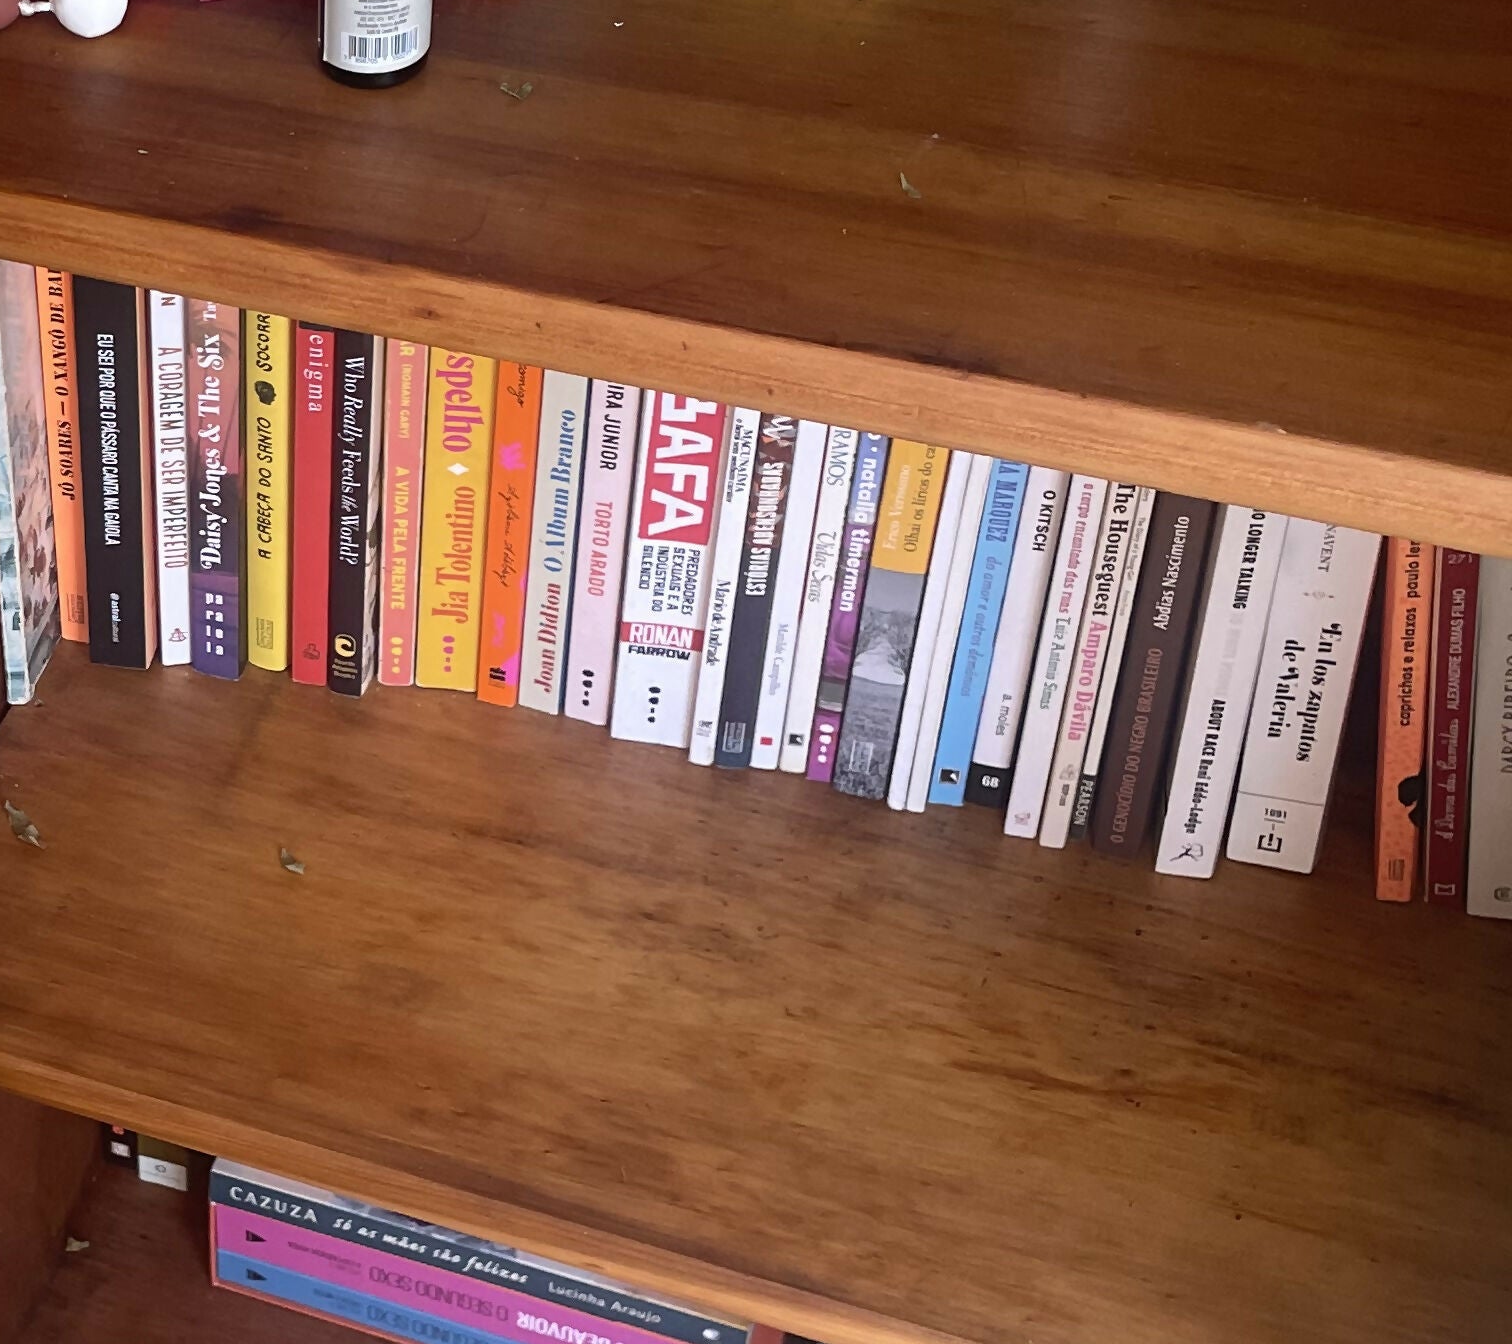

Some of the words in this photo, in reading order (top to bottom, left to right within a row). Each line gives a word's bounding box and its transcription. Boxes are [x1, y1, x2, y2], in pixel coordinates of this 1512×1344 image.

[50, 302, 65, 324] DE
[48, 329, 68, 382] XANGÔ
[97, 333, 115, 347] EU
[97, 349, 116, 366] SEI
[158, 347, 183, 356] A
[196, 334, 224, 371] Six
[256, 314, 273, 372] SOCORR
[55, 386, 69, 396] O
[98, 367, 116, 388] POR
[303, 334, 329, 412] enigma
[344, 356, 365, 393] Who
[99, 389, 116, 410] QUE
[158, 362, 185, 432] CORAGEM
[197, 375, 221, 418] The
[435, 354, 484, 453] spelho
[100, 412, 117, 420] O
[197, 423, 221, 443] &
[337, 394, 364, 447] Really
[58, 419, 74, 480] SOARES
[100, 421, 120, 466] PÁSSARO
[160, 435, 185, 455] DE
[257, 416, 273, 464] SANTO
[550, 409, 577, 484] Branco
[599, 414, 622, 471] JUNIOR
[826, 429, 852, 487] RAMOS
[102, 467, 120, 496] CANTA
[162, 459, 185, 485] SER
[199, 448, 228, 507] Jones
[258, 467, 273, 487] DO
[341, 448, 362, 498] Feeds
[395, 466, 411, 476] A
[917, 462, 933, 476] do
[102, 497, 121, 510] NA
[394, 481, 410, 514] VIDA
[1043, 490, 1056, 501] O
[1077, 492, 1092, 519] corpo
[104, 512, 122, 546] GAIOLA
[162, 491, 189, 570] IMPERFEITO
[256, 492, 274, 544] CABEÇA
[592, 502, 613, 551] TORTO
[913, 509, 924, 520] os
[1032, 507, 1054, 552] KITSCH
[199, 504, 228, 570] Daisy
[258, 548, 272, 560] A
[339, 515, 360, 565] World?
[393, 519, 409, 554] PELA
[435, 486, 476, 586] Tolentino
[1067, 520, 1086, 570] encantado
[1162, 516, 1190, 588] Nascimento
[1241, 523, 1264, 564] LONGER
[390, 557, 407, 610] FRENTE
[543, 557, 563, 573] O
[587, 552, 607, 597] ARADO
[669, 547, 686, 592] SEXUAIS
[681, 548, 701, 616] PREDADORES
[1063, 571, 1075, 589] das
[1092, 519, 1130, 617] Houseguest
[1405, 560, 1421, 599] paulo
[651, 599, 663, 612] DO
[980, 572, 993, 602] amor
[1058, 591, 1073, 614] ruas
[1232, 567, 1255, 610] TALKING
[431, 591, 469, 625] Jia
[538, 583, 561, 645] Didion
[1153, 588, 1175, 630] Abdias
[629, 623, 693, 648] RONAN
[706, 626, 724, 666] Andrade
[1317, 622, 1342, 654] En
[1401, 607, 1417, 654] relaxos
[1449, 617, 1465, 654] DUMAS
[628, 645, 690, 661] FARROW
[1078, 621, 1108, 687] Amparo
[1283, 639, 1306, 663] de
[1404, 656, 1414, 665] e
[534, 649, 555, 693] Joan
[1137, 648, 1164, 712] BRASILEIRO
[1311, 657, 1336, 687] los
[1207, 699, 1226, 731] ABOUT
[1267, 666, 1299, 738] Valeria
[1398, 666, 1416, 727] caprichos
[1067, 690, 1094, 741] Dávila
[1130, 715, 1149, 749] NEGRO
[1296, 689, 1324, 763] zapatos
[1129, 751, 1141, 771] DO
[1201, 733, 1219, 757] RACE
[981, 775, 999, 788] 68
[1074, 778, 1095, 826] PEARSON
[1110, 834, 1124, 844] O
[229, 1186, 318, 1224] CAZUZA
[357, 1225, 378, 1239] as
[462, 1255, 529, 1284] felizes
[548, 1281, 606, 1308] Lucinha
[610, 1300, 662, 1324] Araujo
[368, 1265, 413, 1292] SEXO
[366, 1304, 410, 1330] SEXO
[415, 1280, 494, 1318] SEGUNDO
[496, 1307, 509, 1322] O
